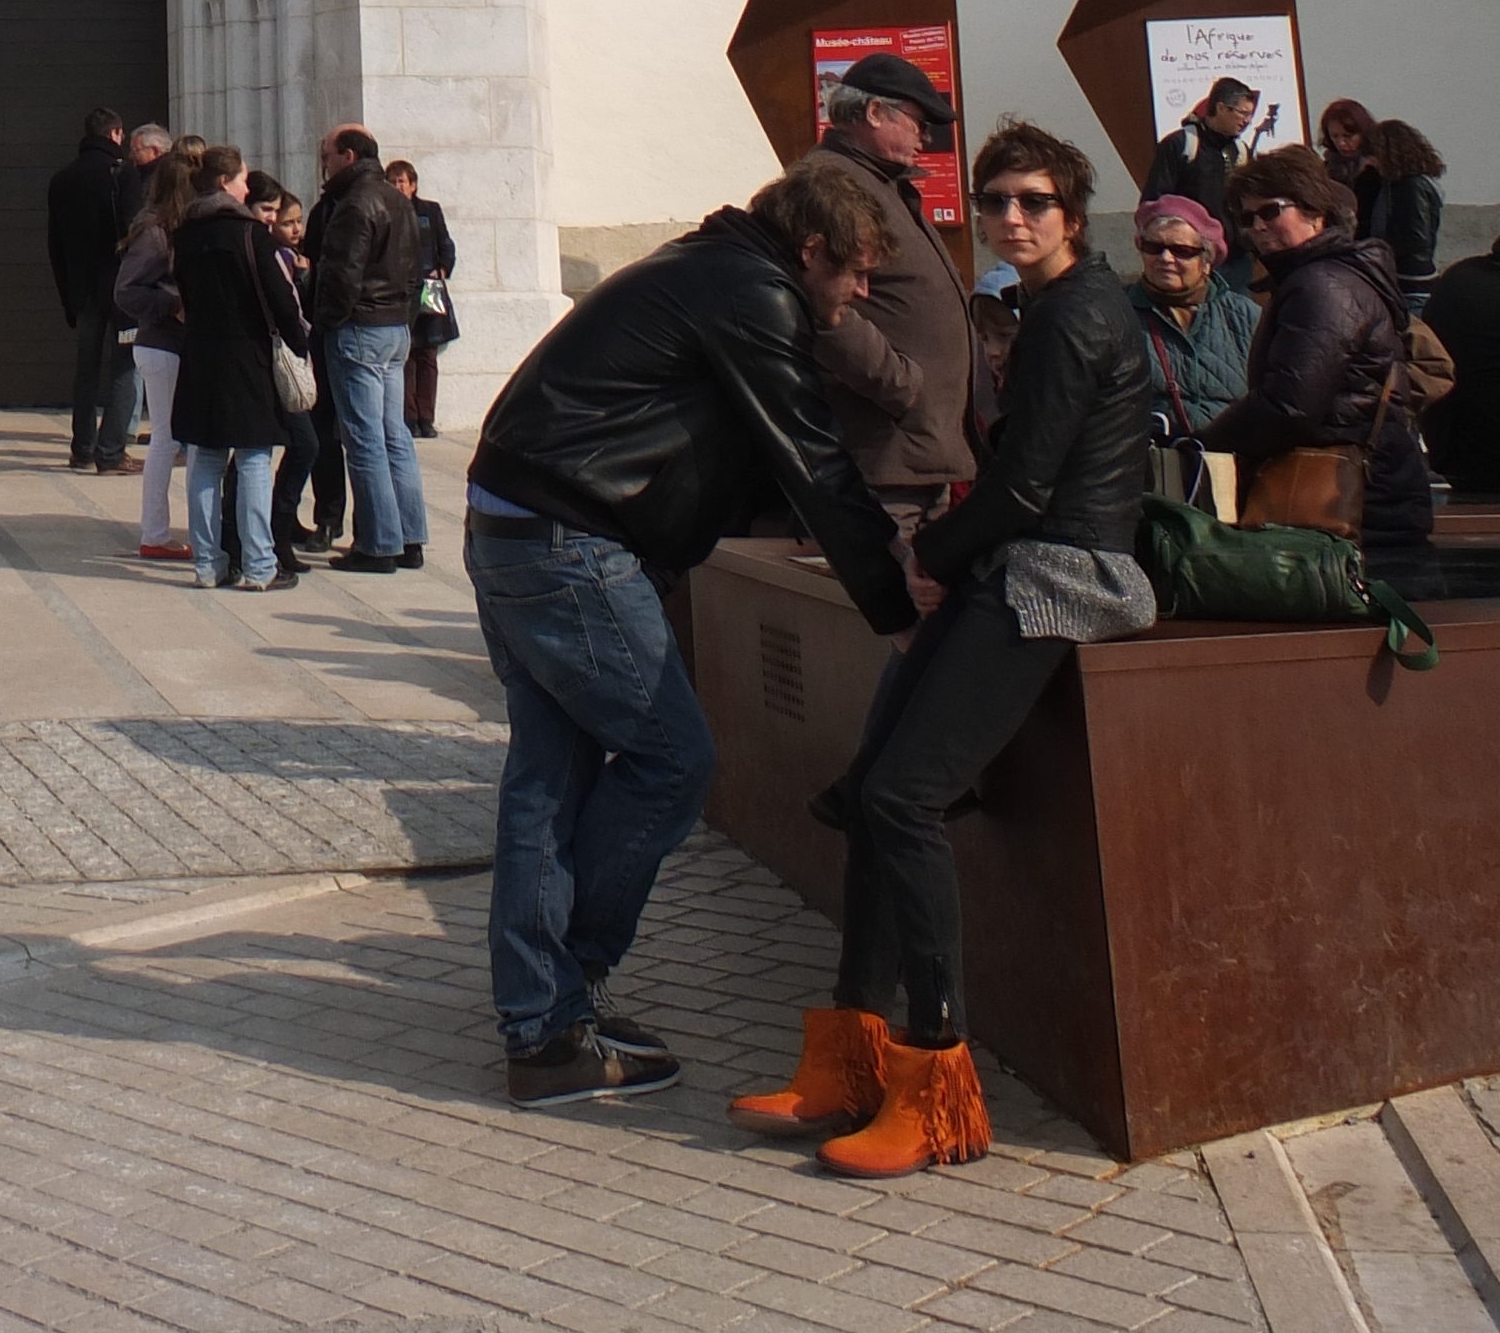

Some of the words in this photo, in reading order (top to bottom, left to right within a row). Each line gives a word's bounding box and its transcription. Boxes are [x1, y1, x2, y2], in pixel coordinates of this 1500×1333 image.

[1185, 24, 1254, 49] l'Afrique
[1160, 49, 1177, 62] de
[1185, 51, 1210, 62] nos
[1217, 49, 1283, 60] réserves
